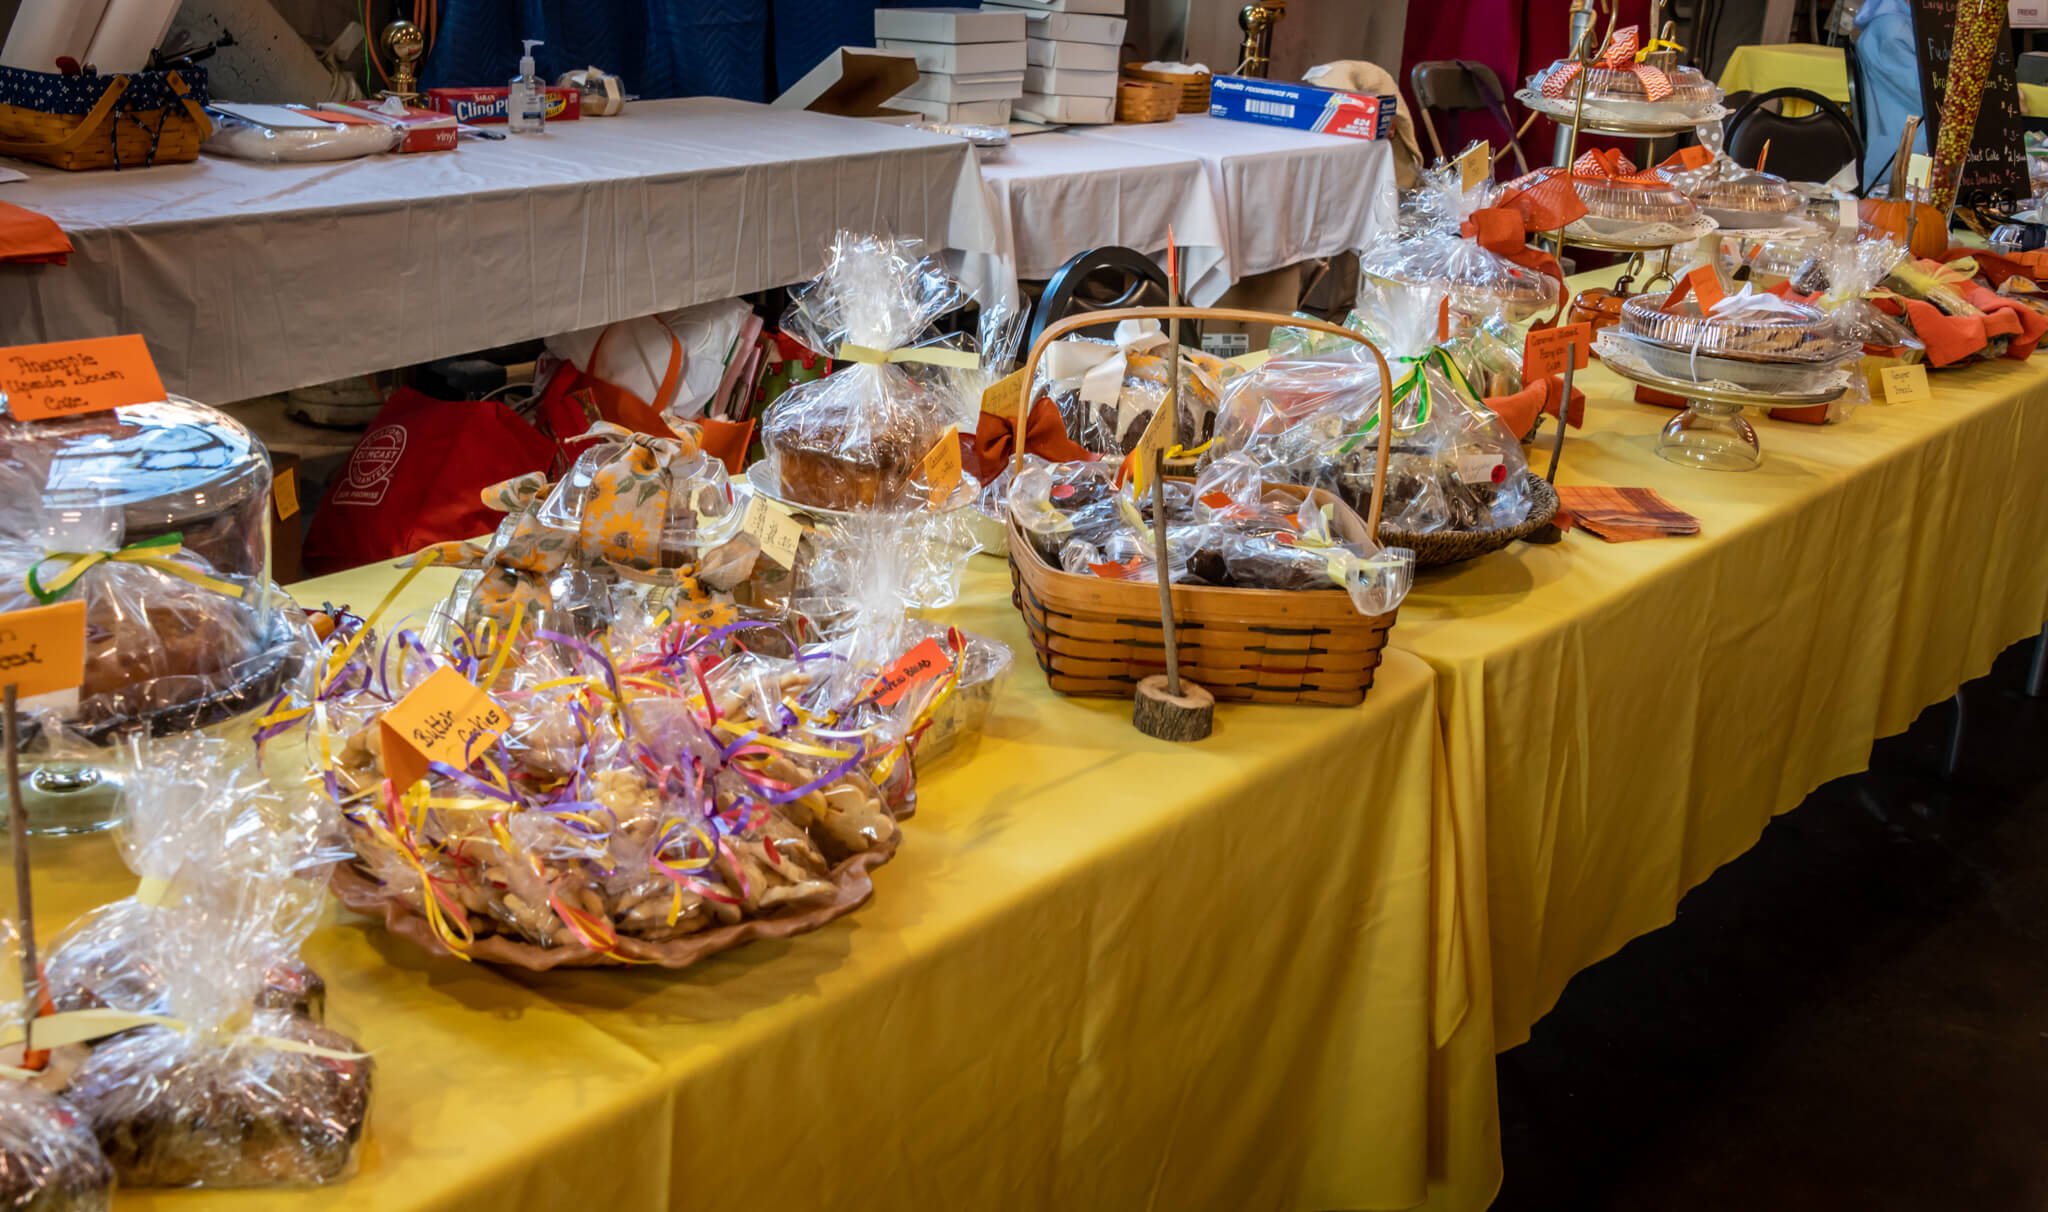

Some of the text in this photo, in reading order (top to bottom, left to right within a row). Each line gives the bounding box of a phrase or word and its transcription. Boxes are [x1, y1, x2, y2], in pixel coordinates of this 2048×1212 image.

[456, 100, 494, 122] Cling
[436, 130, 456, 145] vinyl
[356, 451, 398, 460] COMCAST
